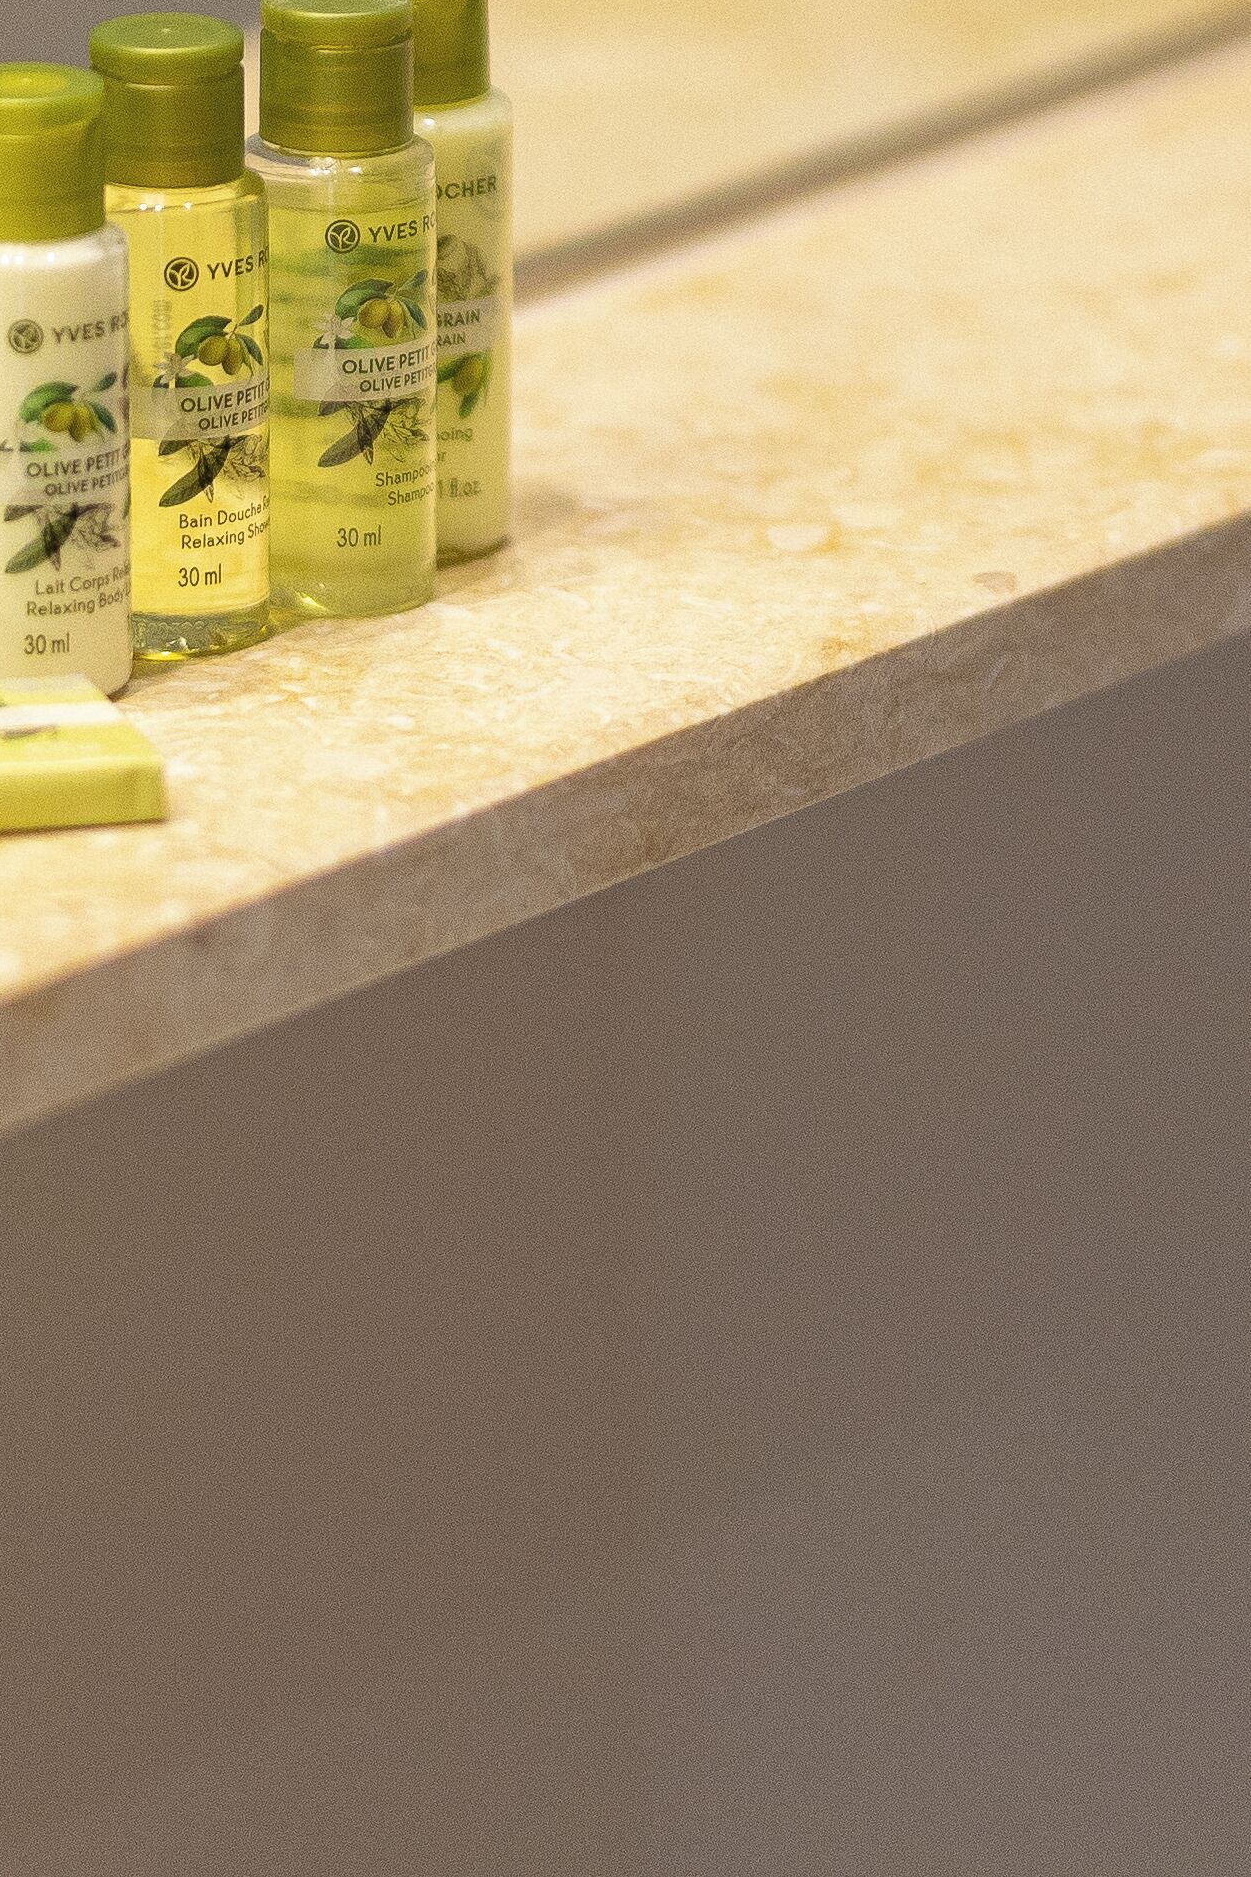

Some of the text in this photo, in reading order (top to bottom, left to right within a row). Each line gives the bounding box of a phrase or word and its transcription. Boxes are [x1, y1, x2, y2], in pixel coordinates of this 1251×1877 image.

[368, 220, 418, 243] YVES
[207, 255, 253, 280] YVES
[53, 321, 105, 343] YVES
[342, 355, 395, 374] OLIVE
[399, 345, 429, 369] PETIT
[360, 375, 401, 392] OLIVE
[181, 392, 233, 412] OLIVE
[236, 380, 264, 406] PETIT
[198, 412, 239, 431] OLIVE
[27, 459, 81, 477] OLIVE
[86, 449, 120, 472] PETIT
[44, 479, 89, 496] OLIVE
[179, 514, 212, 528] Bain
[181, 531, 245, 549] Relaxing
[337, 525, 381, 547] 30 ml
[35, 580, 65, 595] Lait
[70, 575, 110, 591] Corps
[178, 563, 222, 587] 30 ml
[27, 599, 95, 615] Relaxing
[24, 632, 70, 655] 30 ml
